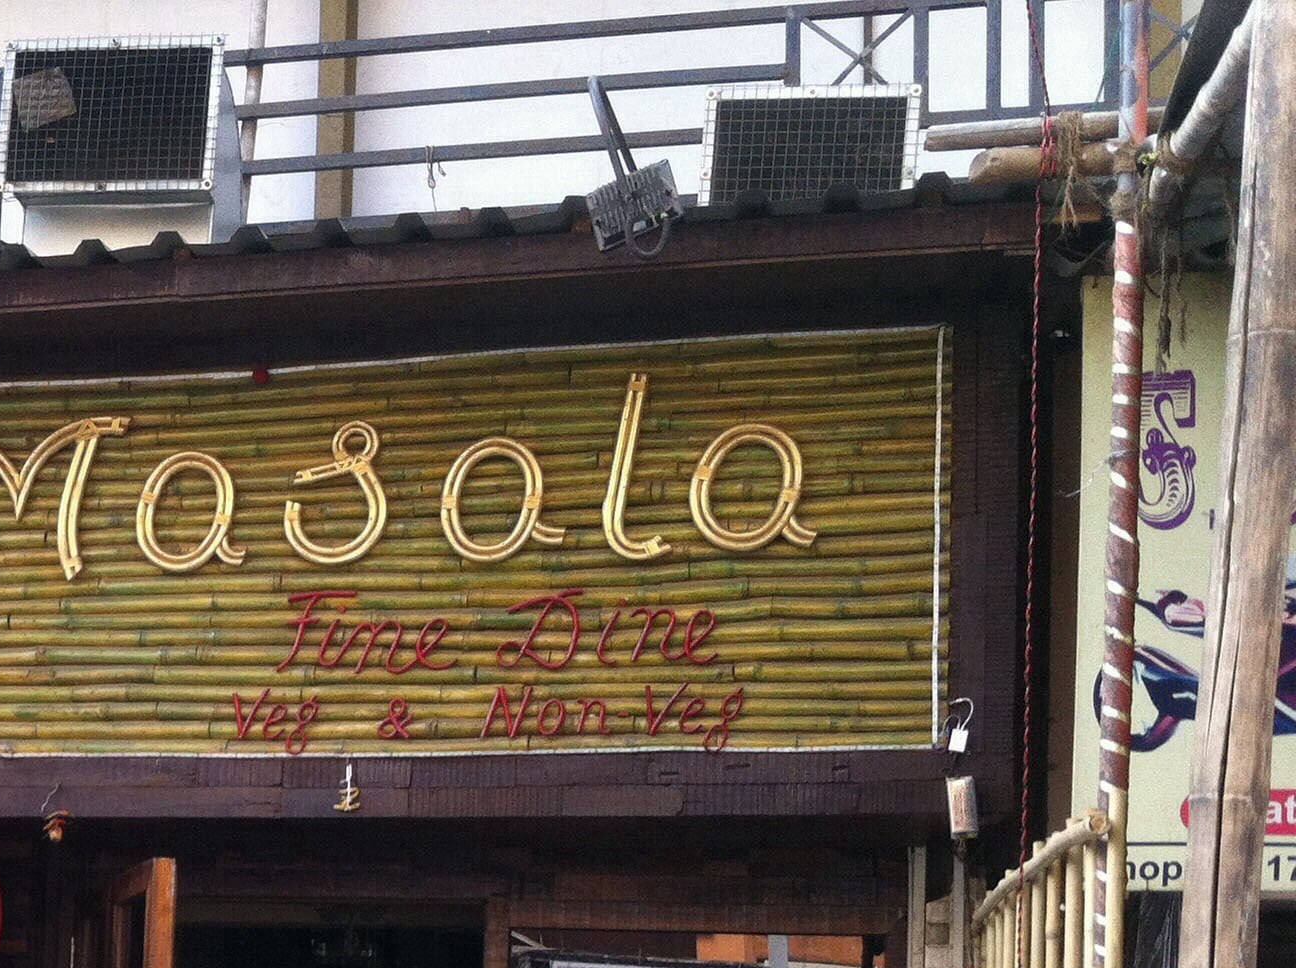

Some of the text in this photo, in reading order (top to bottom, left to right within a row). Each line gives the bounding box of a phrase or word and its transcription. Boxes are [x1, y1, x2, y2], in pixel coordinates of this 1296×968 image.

[277, 588, 718, 675] Fine Dine
[233, 682, 745, 755] Veg & Non-Veg
